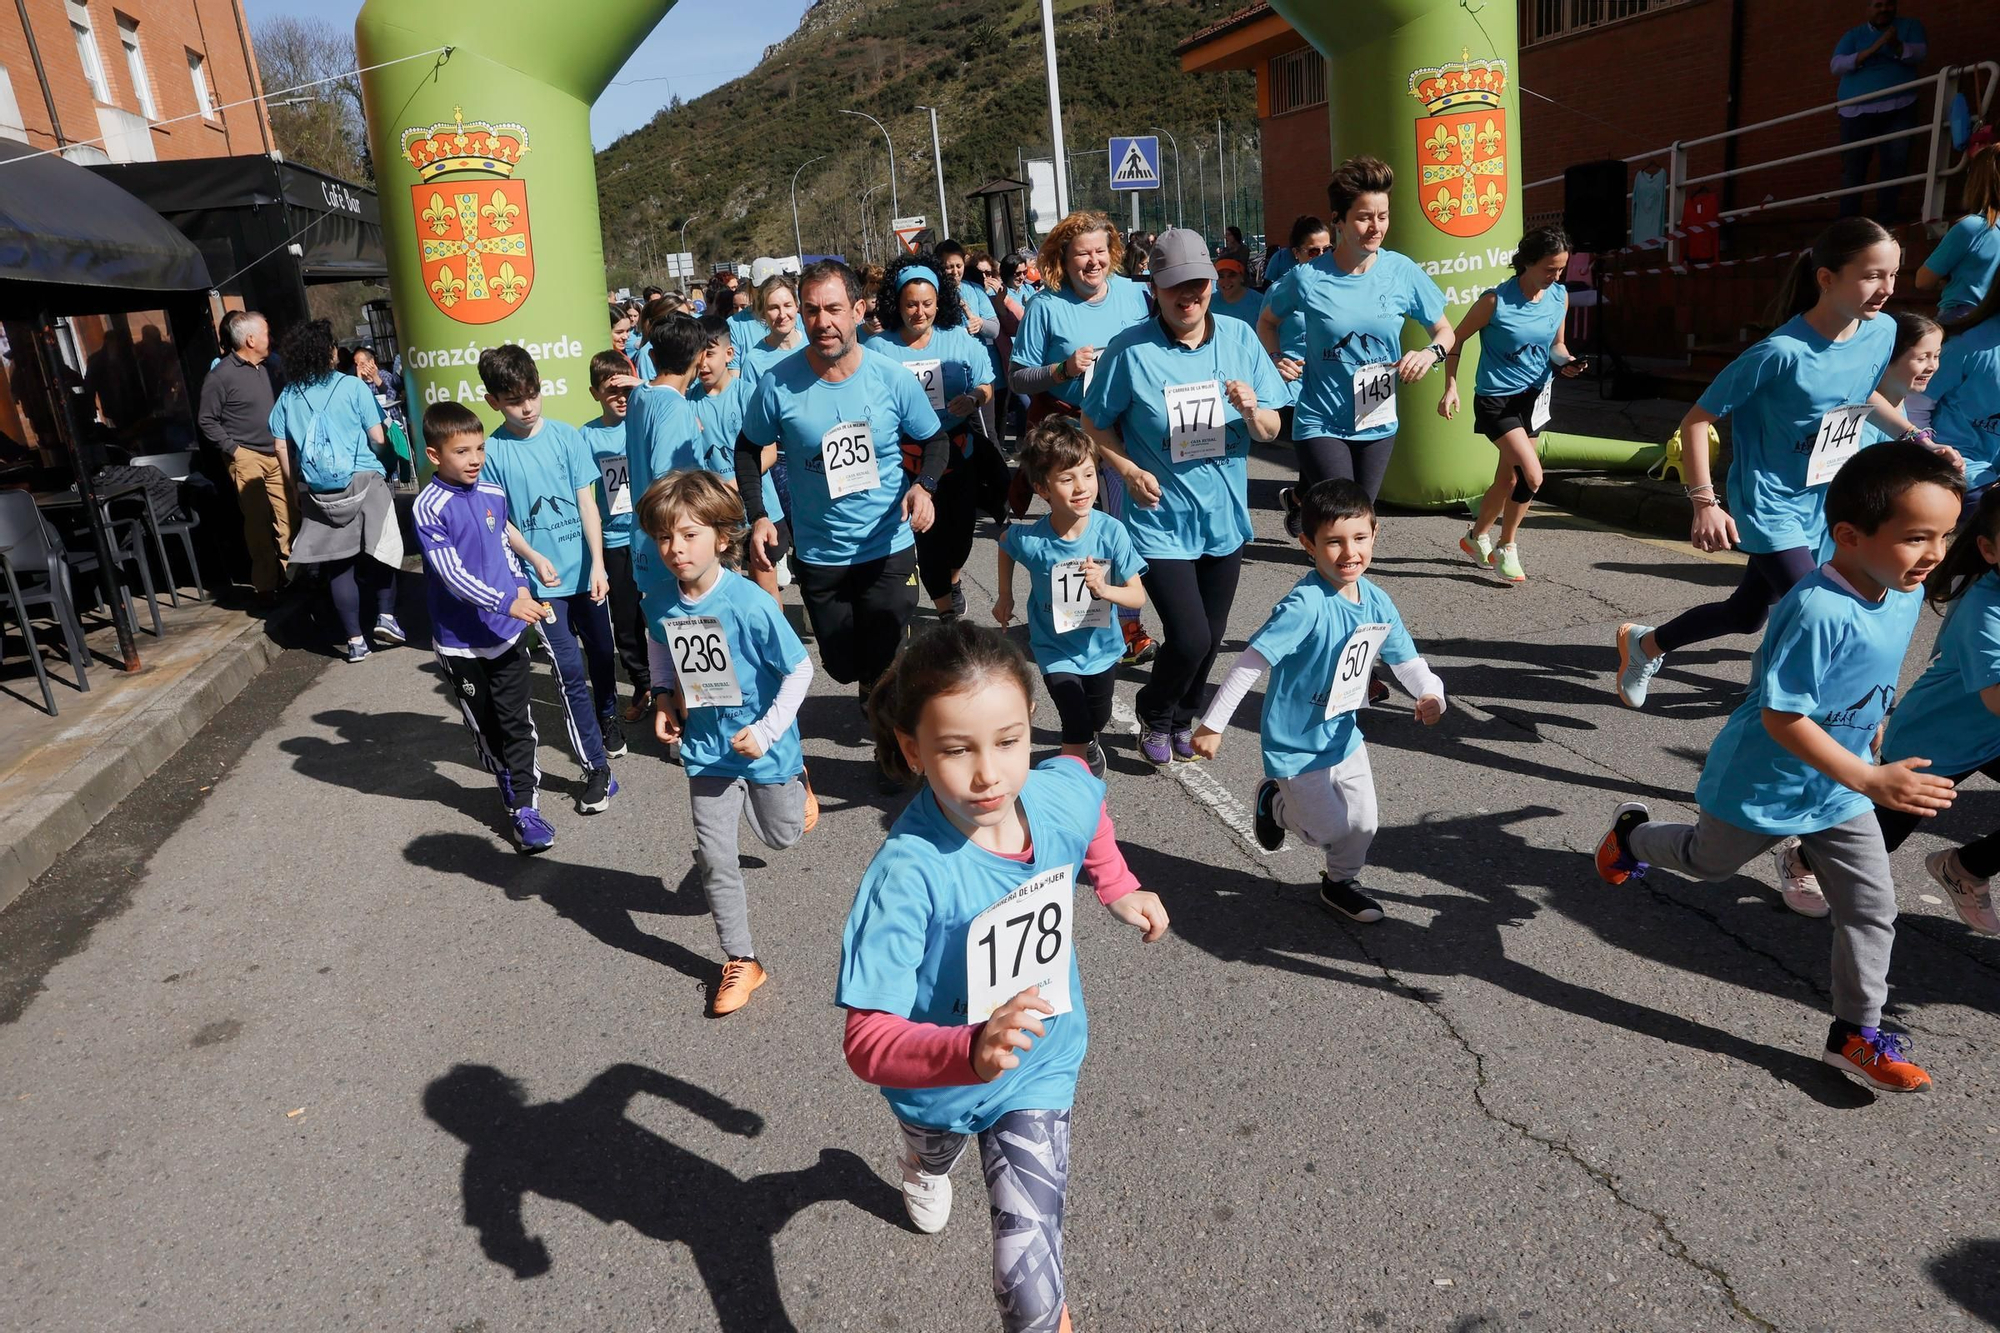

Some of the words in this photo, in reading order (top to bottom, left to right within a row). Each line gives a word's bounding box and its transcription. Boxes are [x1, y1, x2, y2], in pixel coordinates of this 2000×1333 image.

[343, 188, 361, 214] Bar
[425, 382, 450, 404] de
[1358, 373, 1391, 405] 143
[1173, 397, 1216, 433] 177
[1821, 413, 1862, 453] 144
[826, 434, 870, 470] 235
[1057, 573, 1101, 602] 17
[674, 633, 727, 673] 236
[1342, 640, 1369, 681] 50
[1018, 886, 1028, 897] DE
[1030, 882, 1039, 893] LA
[978, 902, 1062, 988] 178
